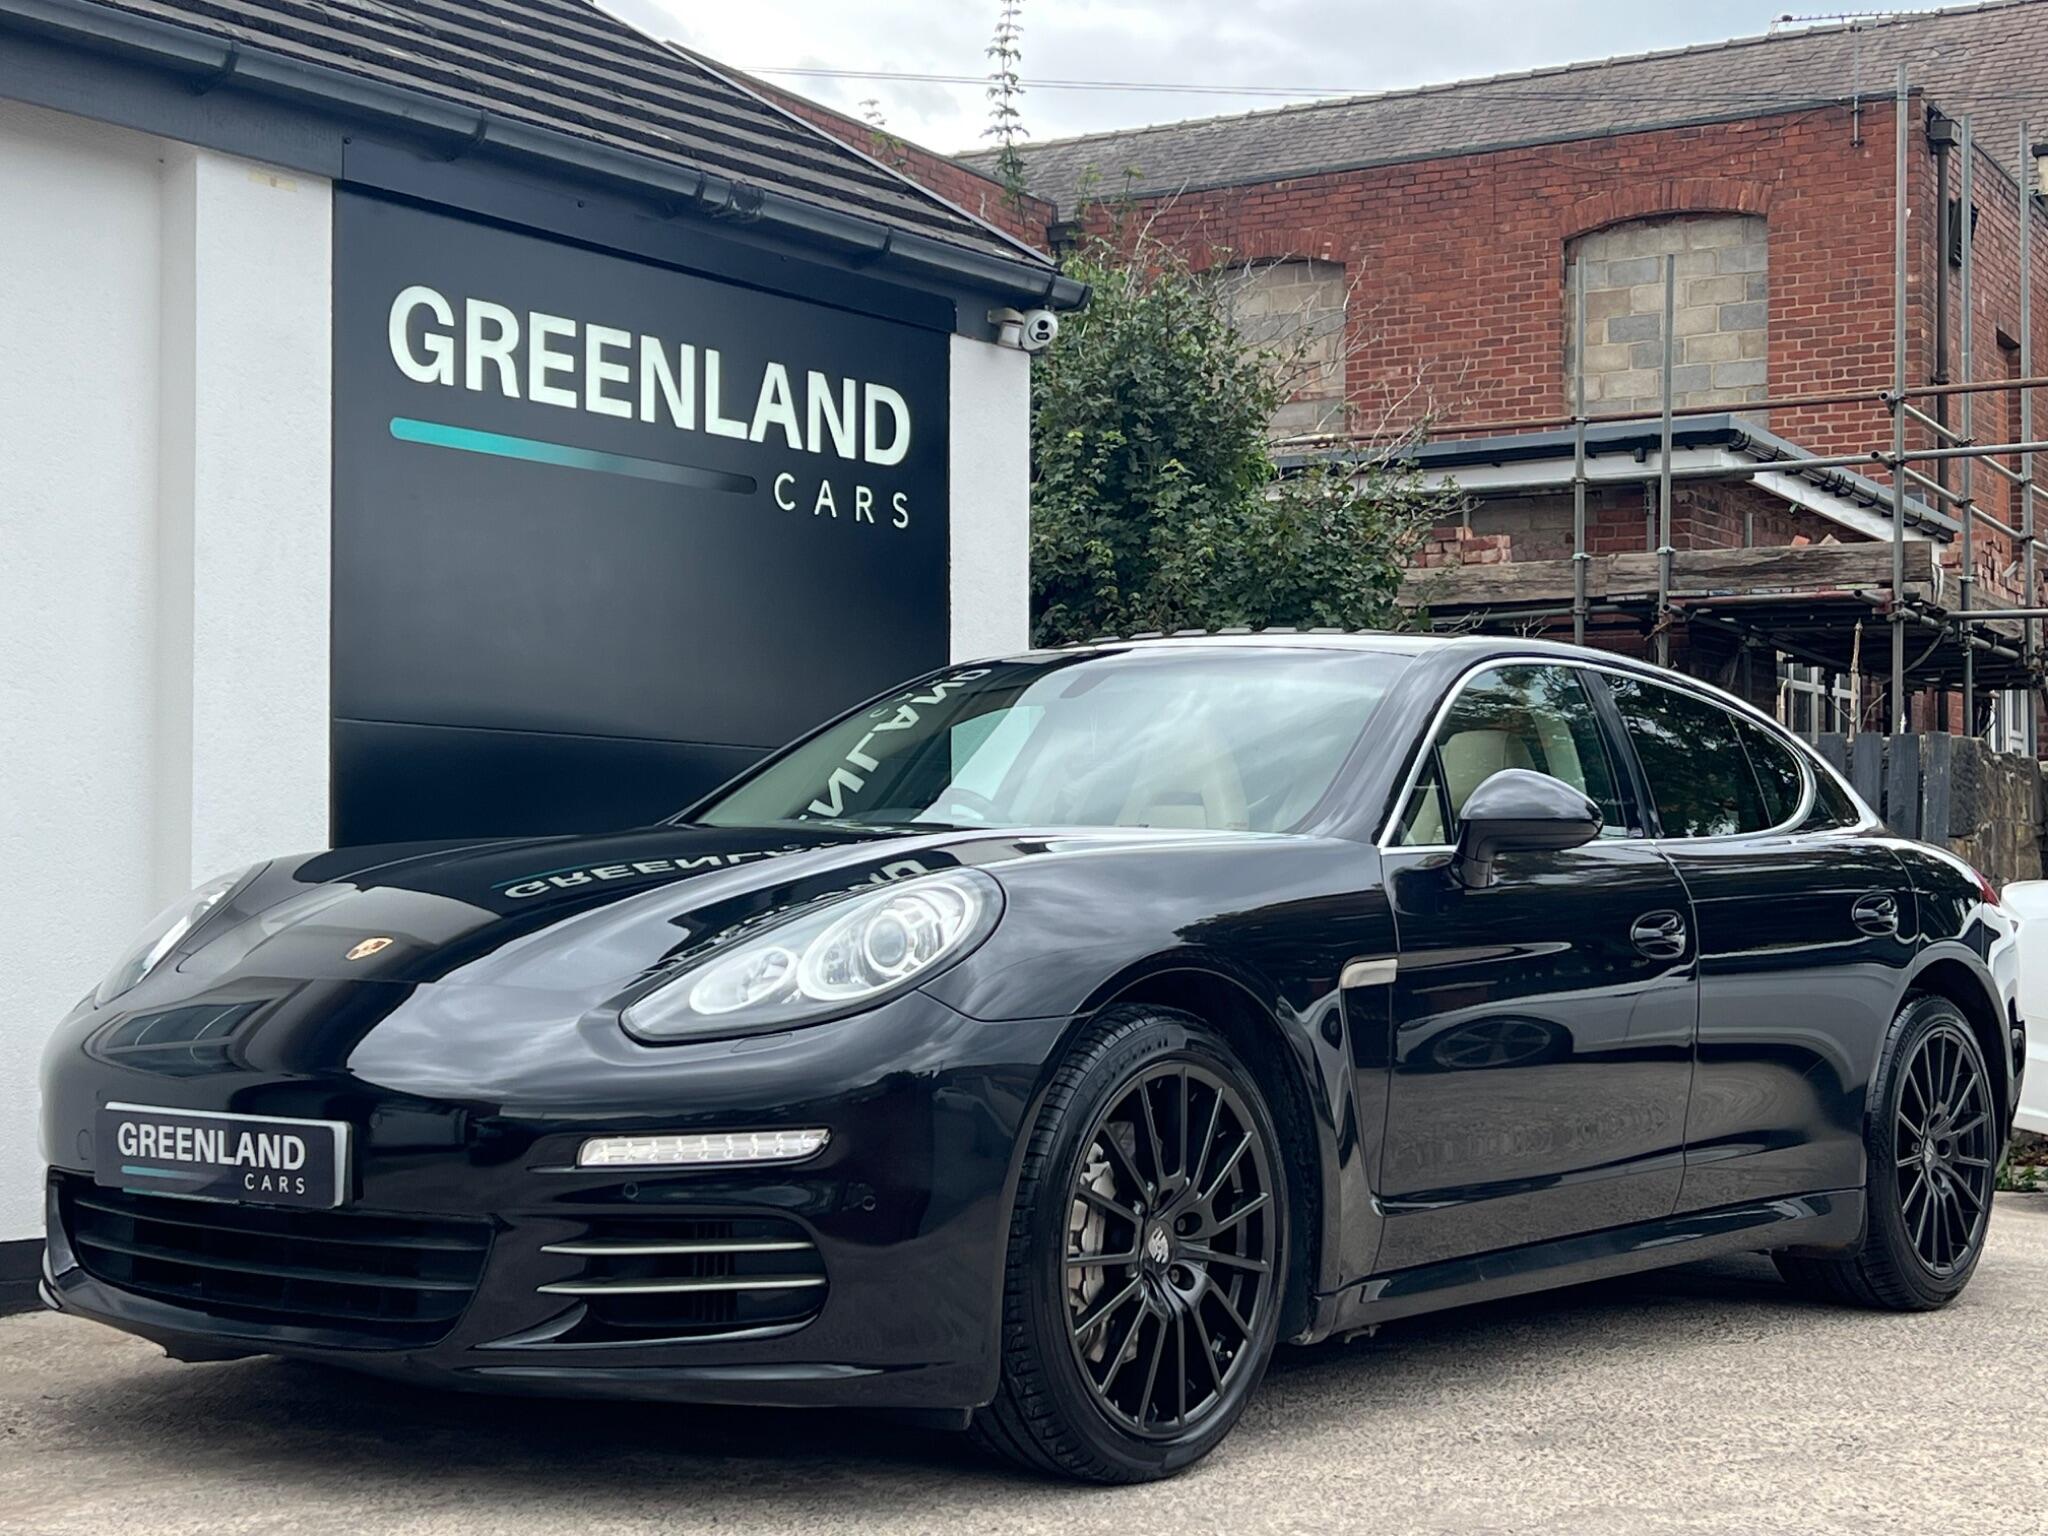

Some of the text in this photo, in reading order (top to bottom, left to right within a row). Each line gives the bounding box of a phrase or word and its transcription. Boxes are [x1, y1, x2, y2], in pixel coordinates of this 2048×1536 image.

[389, 286, 910, 466] GREENLAND
[773, 472, 910, 529] CARS
[117, 1121, 306, 1171] GREENLAND
[244, 1174, 305, 1194] CARS
